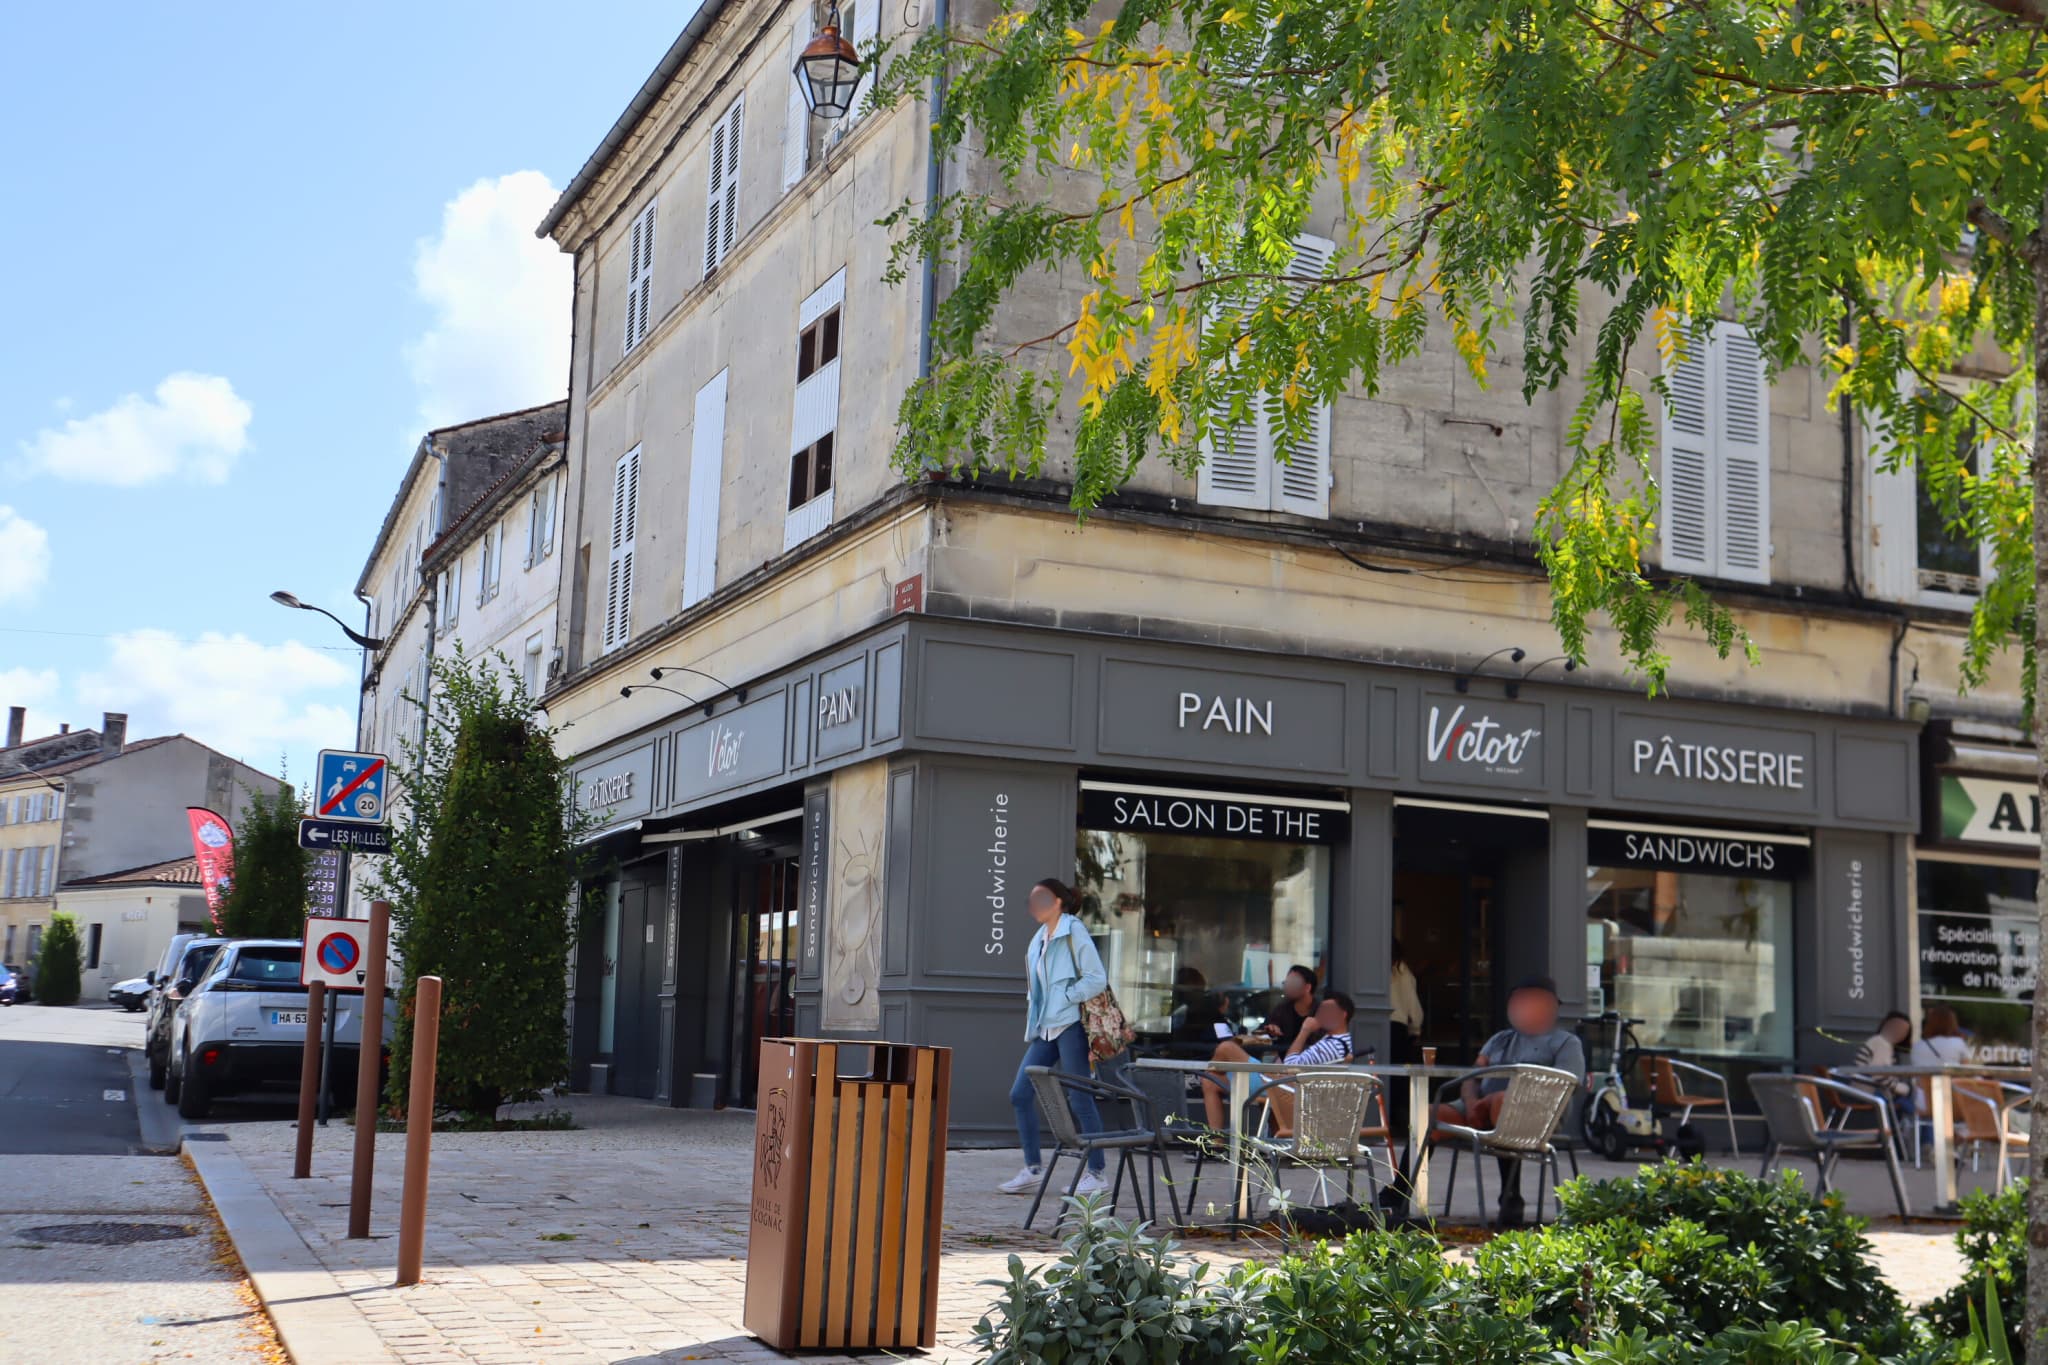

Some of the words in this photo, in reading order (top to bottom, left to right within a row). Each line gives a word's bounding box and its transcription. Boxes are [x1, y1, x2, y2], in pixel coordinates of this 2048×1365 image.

[818, 684, 857, 730] PAIN
[1179, 692, 1272, 736] PAIN
[1428, 705, 1523, 764] Victor
[1634, 735, 1804, 788] PÂTISSERIE
[360, 800, 375, 810] 20
[589, 771, 630, 809] PÂTISSERIE
[331, 829, 349, 843] LES
[1114, 797, 1215, 829] SALON
[1226, 806, 1263, 833] DE
[1271, 809, 1320, 839] THE
[1625, 834, 1775, 870] SANDWICHS
[808, 811, 821, 957] Sandwicherie
[985, 793, 1009, 955] Sandwicherie
[1845, 860, 1865, 999] Sandwicherie
[1921, 946, 1997, 966] rénovation
[1963, 971, 1982, 987] de
[753, 1208, 783, 1233] COGNAC
